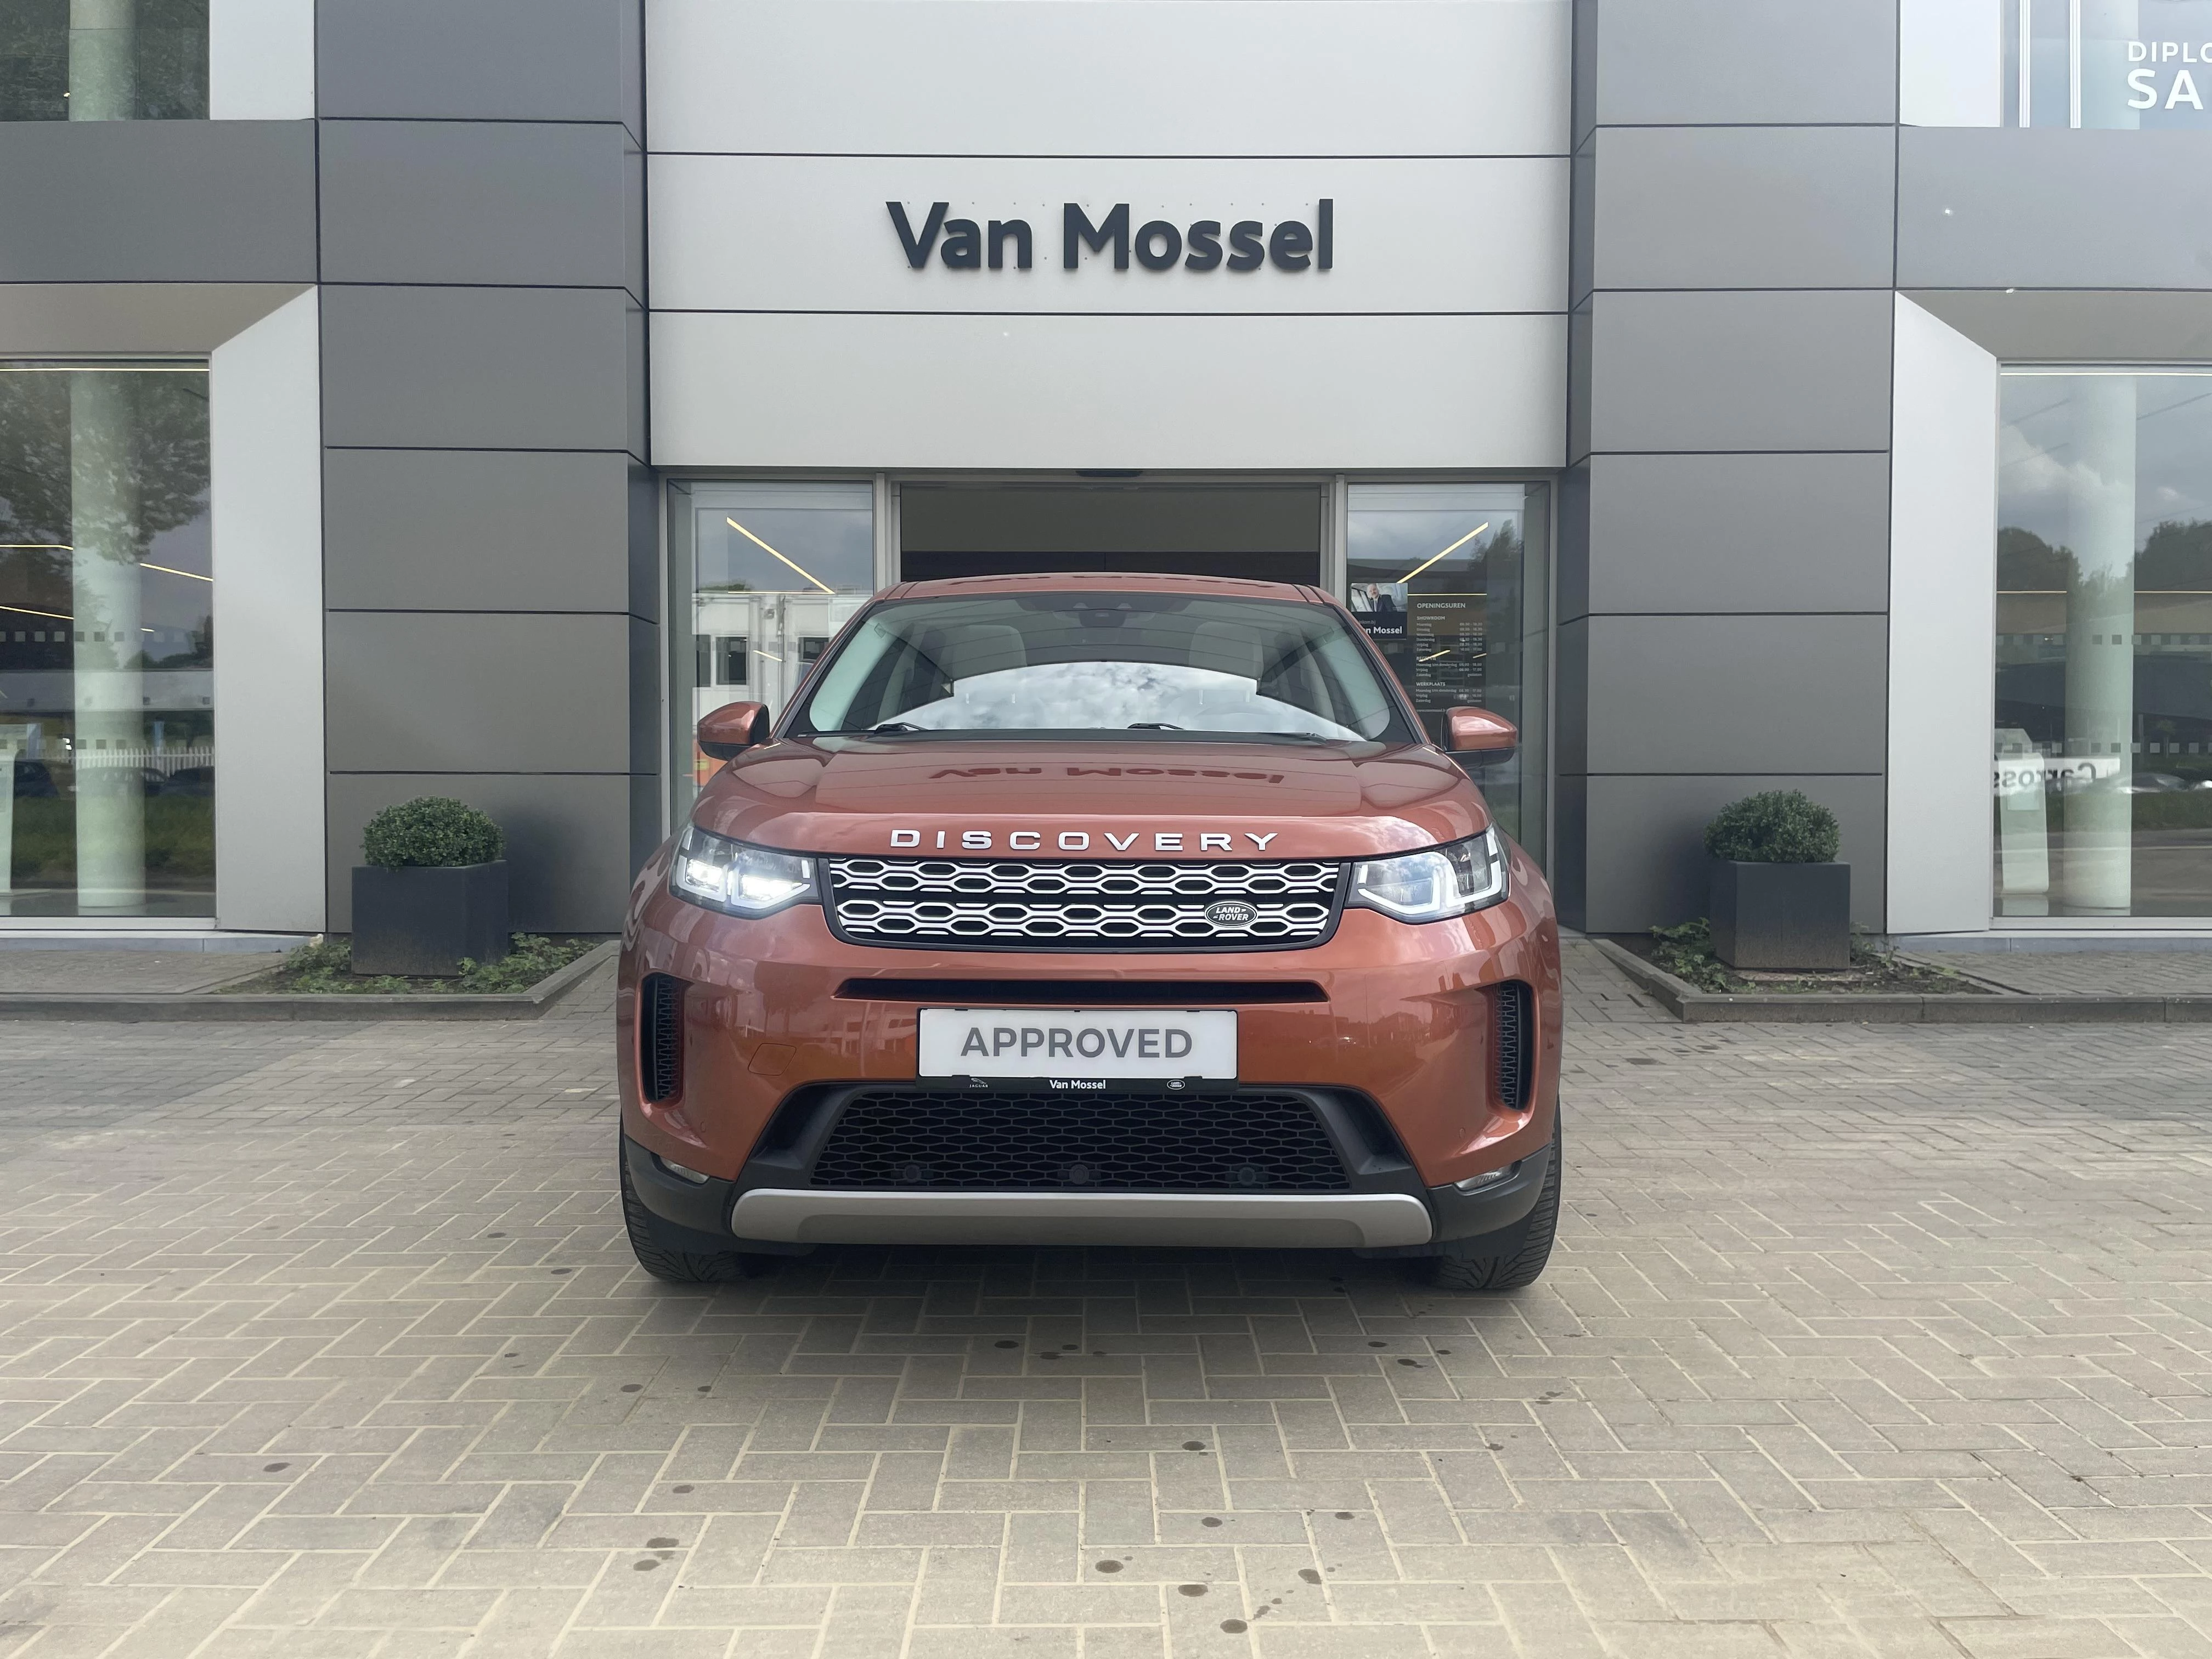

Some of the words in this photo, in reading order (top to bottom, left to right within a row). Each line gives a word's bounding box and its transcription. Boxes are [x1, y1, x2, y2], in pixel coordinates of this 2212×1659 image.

[885, 201, 1032, 270] Van
[1063, 198, 1334, 273] Mossel
[1373, 626, 1402, 634] Mossel
[889, 830, 1278, 852] DISCOVERY
[960, 1026, 1193, 1059] APPROVED
[1049, 1079, 1069, 1089] Van
[1071, 1079, 1106, 1090] Mossel
